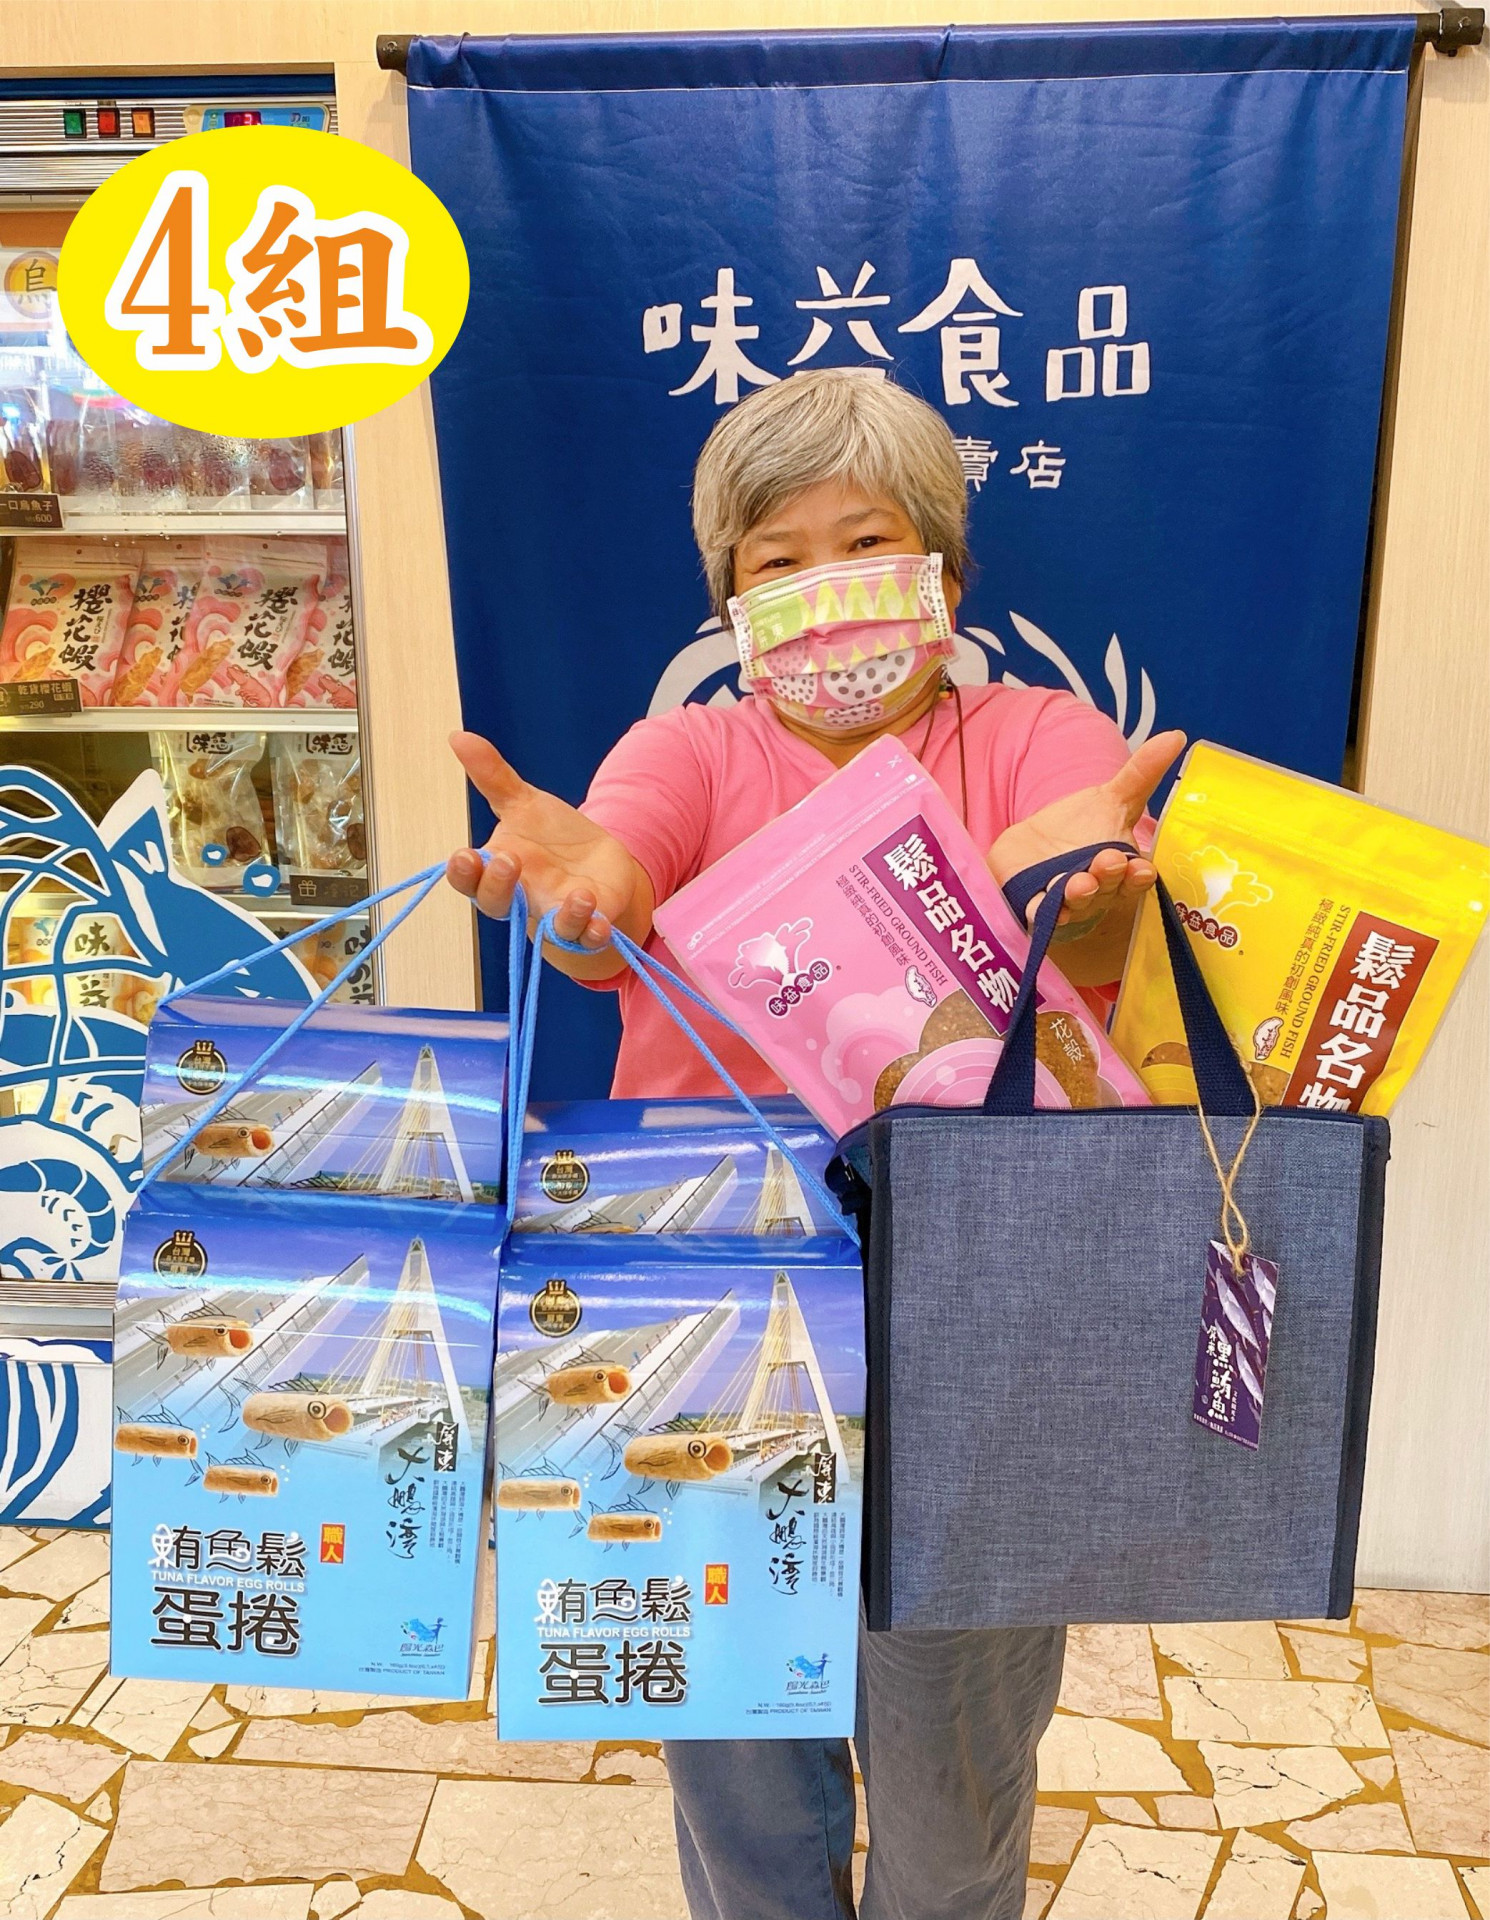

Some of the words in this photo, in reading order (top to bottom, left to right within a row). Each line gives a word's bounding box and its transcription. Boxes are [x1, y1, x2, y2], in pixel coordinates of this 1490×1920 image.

[643, 258, 1150, 407] 味益食品
[58, 584, 113, 672] 櫻花蝦
[849, 864, 894, 918] STIR-FRIED
[890, 916, 928, 961] GROUND
[924, 959, 948, 986] FISH
[884, 833, 1021, 1014] 鬆品名物
[1313, 904, 1351, 973] STIR-FRIED
[768, 960, 832, 1018] 味益食品
[1291, 975, 1320, 1027] GROUND
[1280, 1029, 1299, 1059] FISH
[1207, 1341, 1234, 1422] 黑鮪魚
[148, 1524, 307, 1578] 鮪魚鬆
[322, 1526, 343, 1562] 職人
[151, 1571, 184, 1583] TUNA
[186, 1574, 234, 1586] FLAVOR
[237, 1577, 263, 1590] EGG
[265, 1579, 305, 1592] ROLLS
[534, 1575, 692, 1624] 鮪魚鬆
[707, 1567, 728, 1603] 職人
[151, 1585, 301, 1657] 蛋捲
[537, 1627, 570, 1638] TUNA
[573, 1627, 620, 1638] FLAVOR
[623, 1627, 649, 1638] EGG
[652, 1626, 690, 1638] ROLLS
[538, 1640, 687, 1706] 蛋捲
